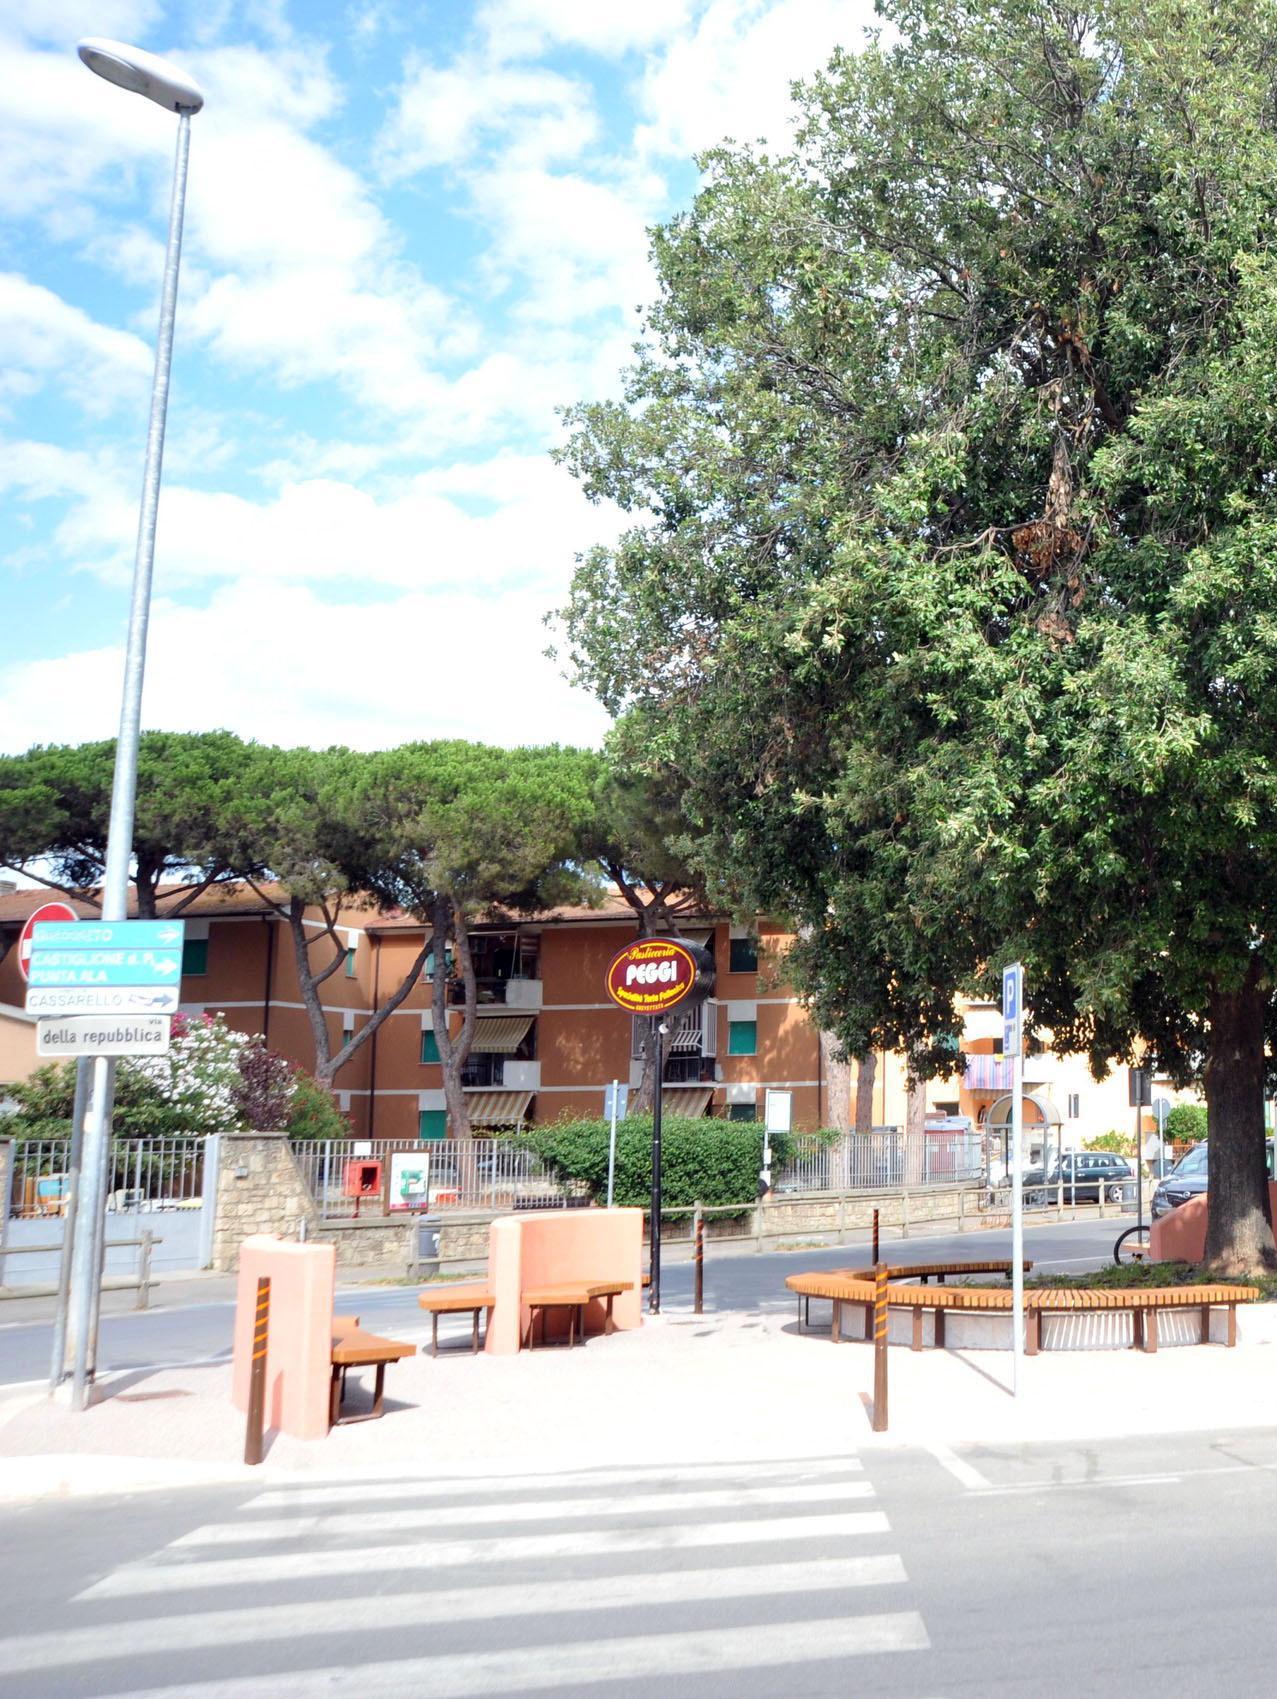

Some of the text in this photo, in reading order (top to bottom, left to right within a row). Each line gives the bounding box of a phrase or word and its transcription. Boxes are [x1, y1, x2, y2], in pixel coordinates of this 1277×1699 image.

[32, 952, 124, 966] CASTIGLIONE
[31, 970, 108, 982] PUNTA ALA
[626, 960, 677, 985] PEGGI
[29, 994, 122, 1007] CASSARELLO
[1007, 980, 1014, 1014] P
[149, 1017, 162, 1025] via
[43, 1028, 162, 1046] della repubblica
